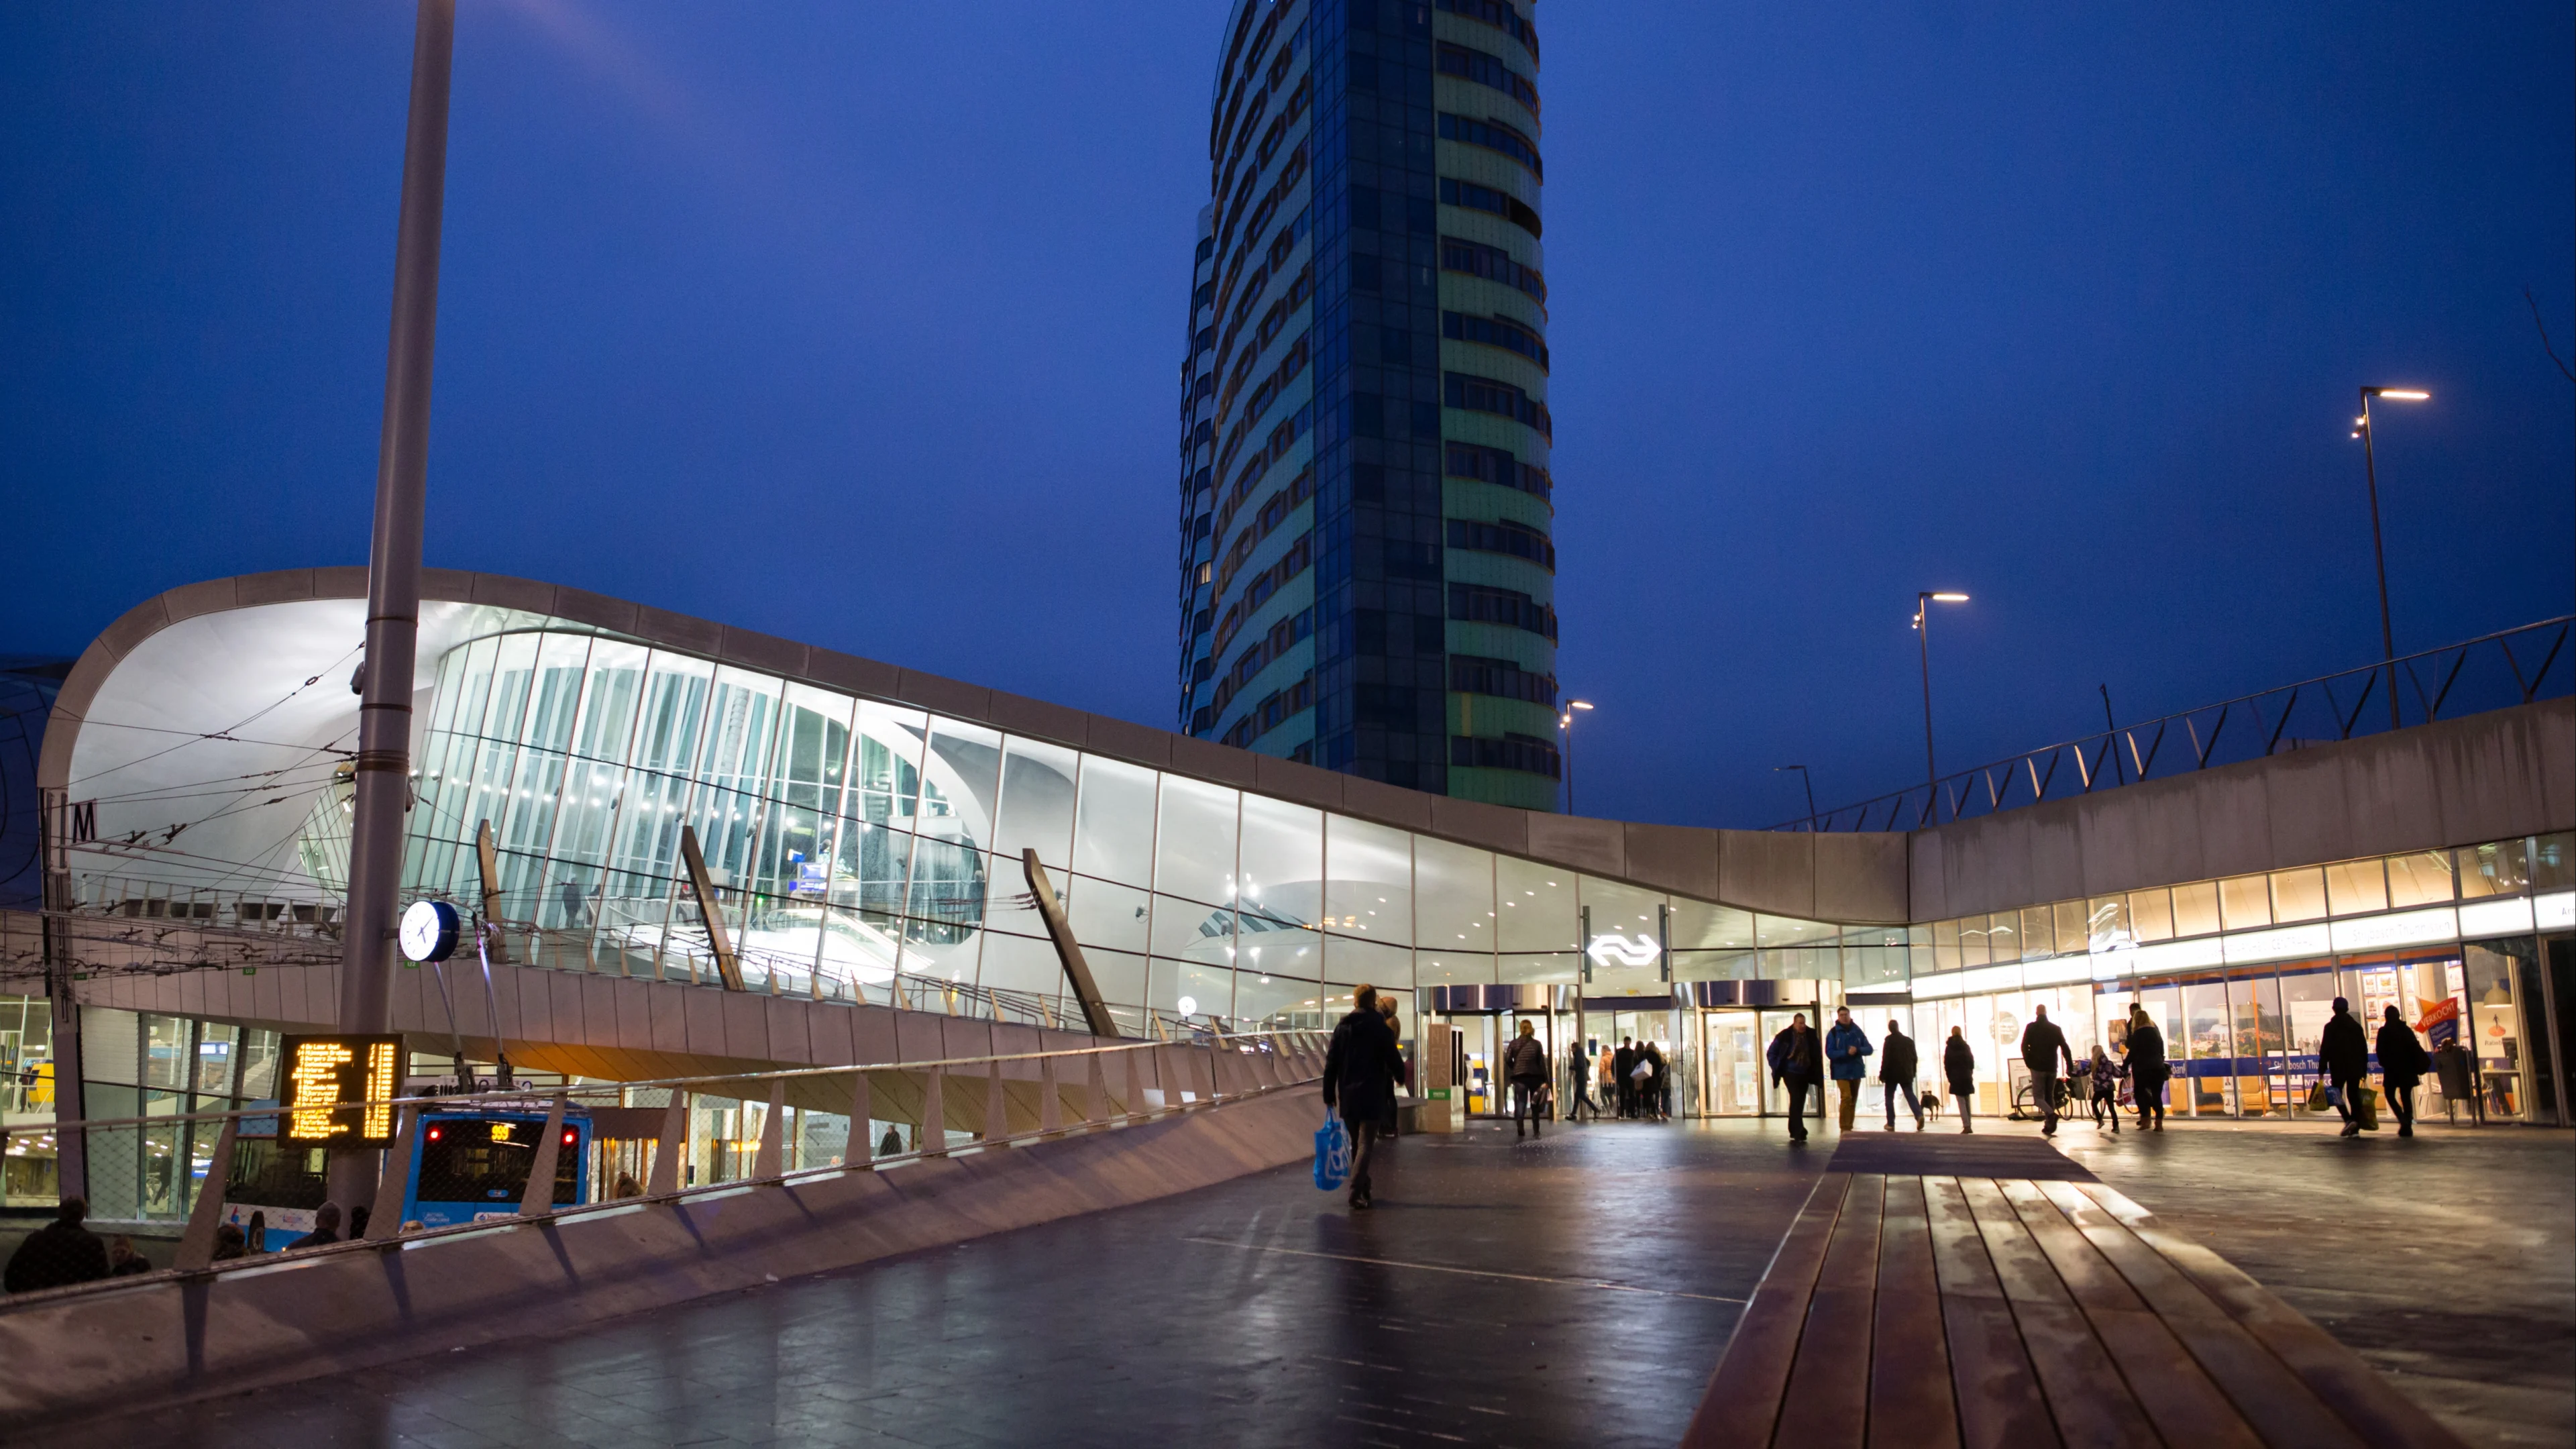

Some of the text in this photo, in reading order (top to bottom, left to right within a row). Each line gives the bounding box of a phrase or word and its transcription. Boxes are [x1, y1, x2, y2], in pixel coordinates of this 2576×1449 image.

[72, 802, 95, 843] M
[2420, 1001, 2455, 1028] VERKOCHT
[2273, 1059, 2306, 1070] Stribosch
[491, 1125, 509, 1140] 999
